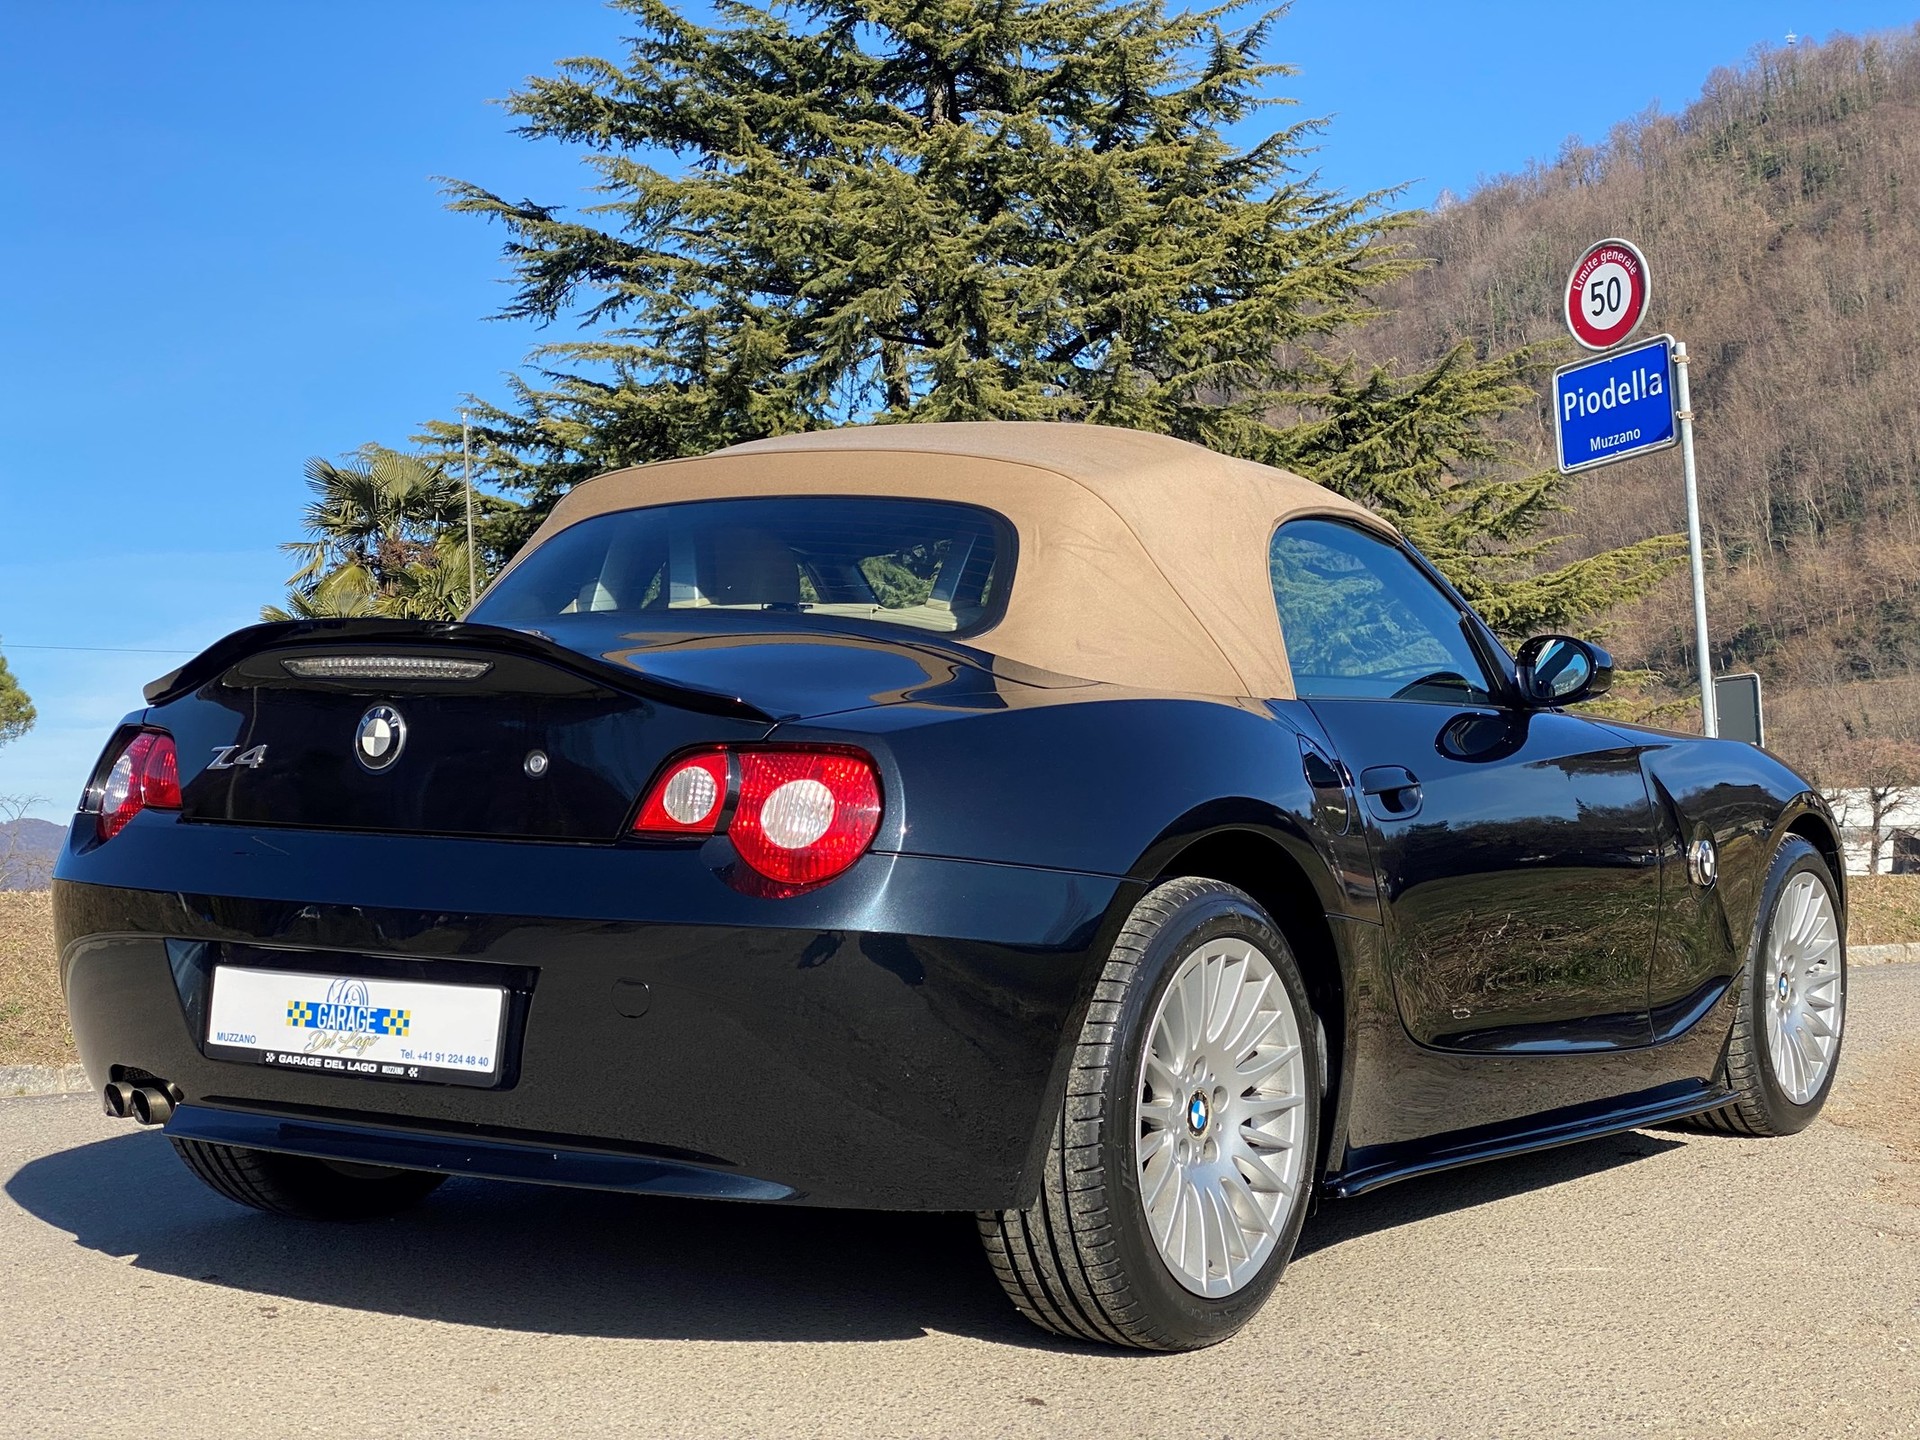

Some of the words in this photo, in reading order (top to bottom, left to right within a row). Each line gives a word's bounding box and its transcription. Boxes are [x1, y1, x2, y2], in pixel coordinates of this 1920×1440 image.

[1573, 258, 1598, 291] Limite
[1600, 250, 1637, 275] generale
[1590, 277, 1621, 317] 50
[1563, 368, 1663, 421] Piodella
[1590, 427, 1641, 452] Muzzano
[207, 744, 268, 770] Z4
[317, 1003, 378, 1033] GARAGE
[217, 1032, 257, 1045] MUZZANO
[303, 1029, 337, 1054] Del
[337, 1029, 380, 1057] Lago
[278, 1054, 322, 1068] GARAGE
[323, 1059, 345, 1070] DEL
[347, 1061, 377, 1073] LAGO
[400, 1049, 415, 1060] Tel.
[417, 1051, 432, 1061] +41
[435, 1052, 445, 1062] 91
[447, 1054, 463, 1064] 224
[465, 1056, 476, 1065] 48
[477, 1057, 489, 1067] 40
